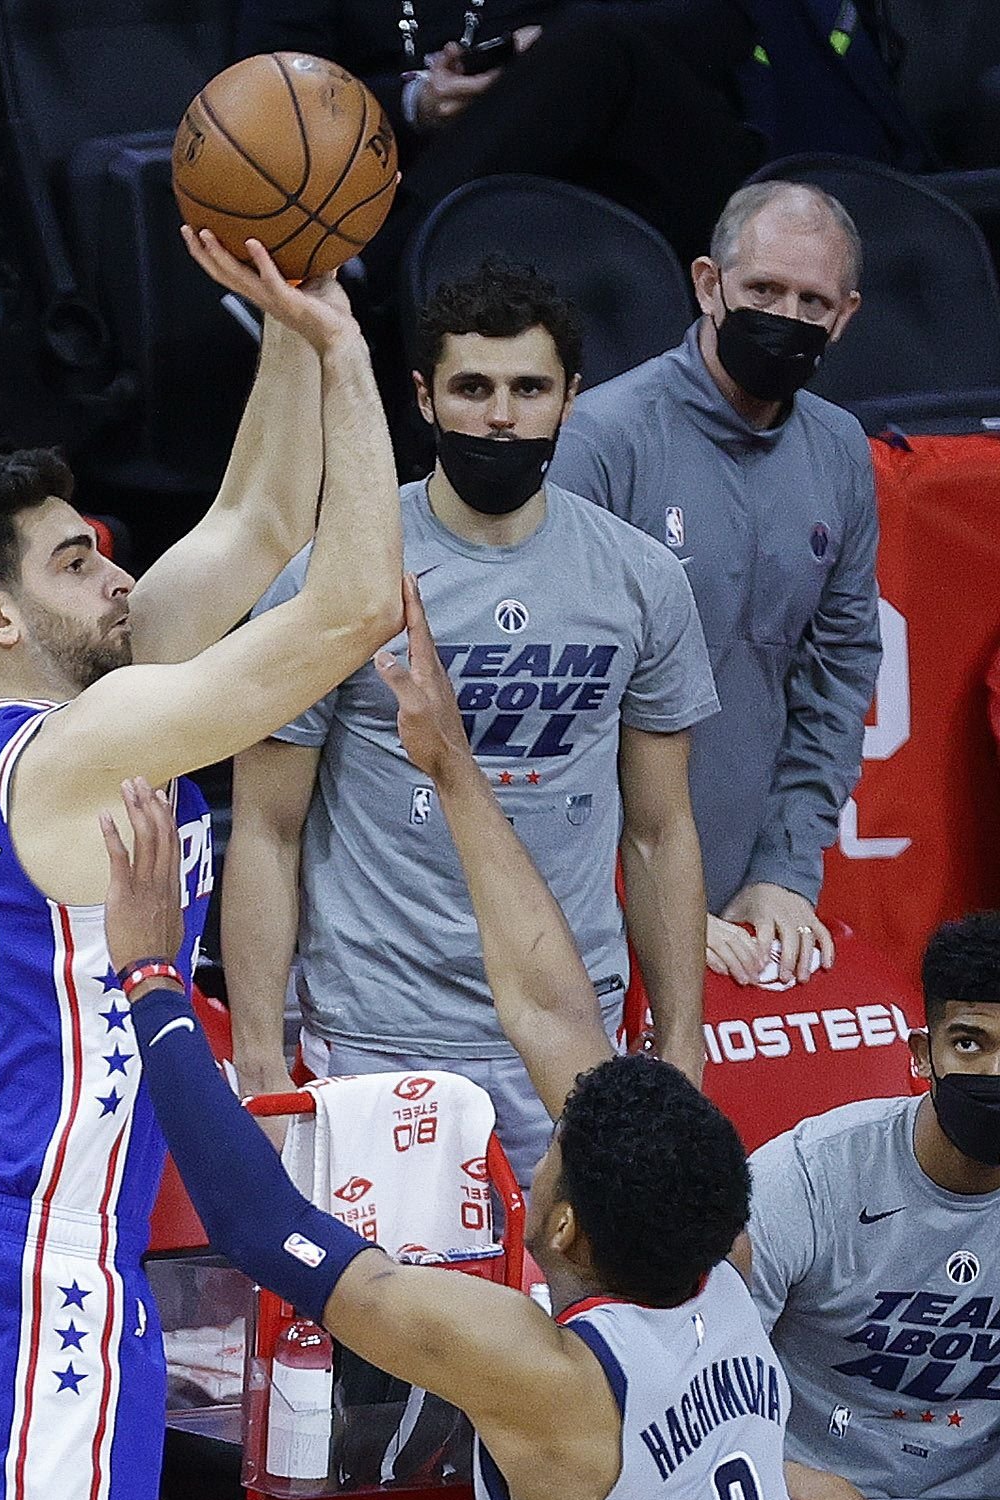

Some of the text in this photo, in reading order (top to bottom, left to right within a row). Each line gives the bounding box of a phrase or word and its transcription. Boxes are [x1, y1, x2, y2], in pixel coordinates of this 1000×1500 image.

[437, 643, 619, 678] TEAM
[456, 681, 611, 711] BOVE
[702, 1002, 929, 1064] IOSTEEL
[865, 1290, 1000, 1329] TEA
[843, 1323, 1000, 1362] ABOV
[639, 1355, 783, 1482] HACHIMURA
